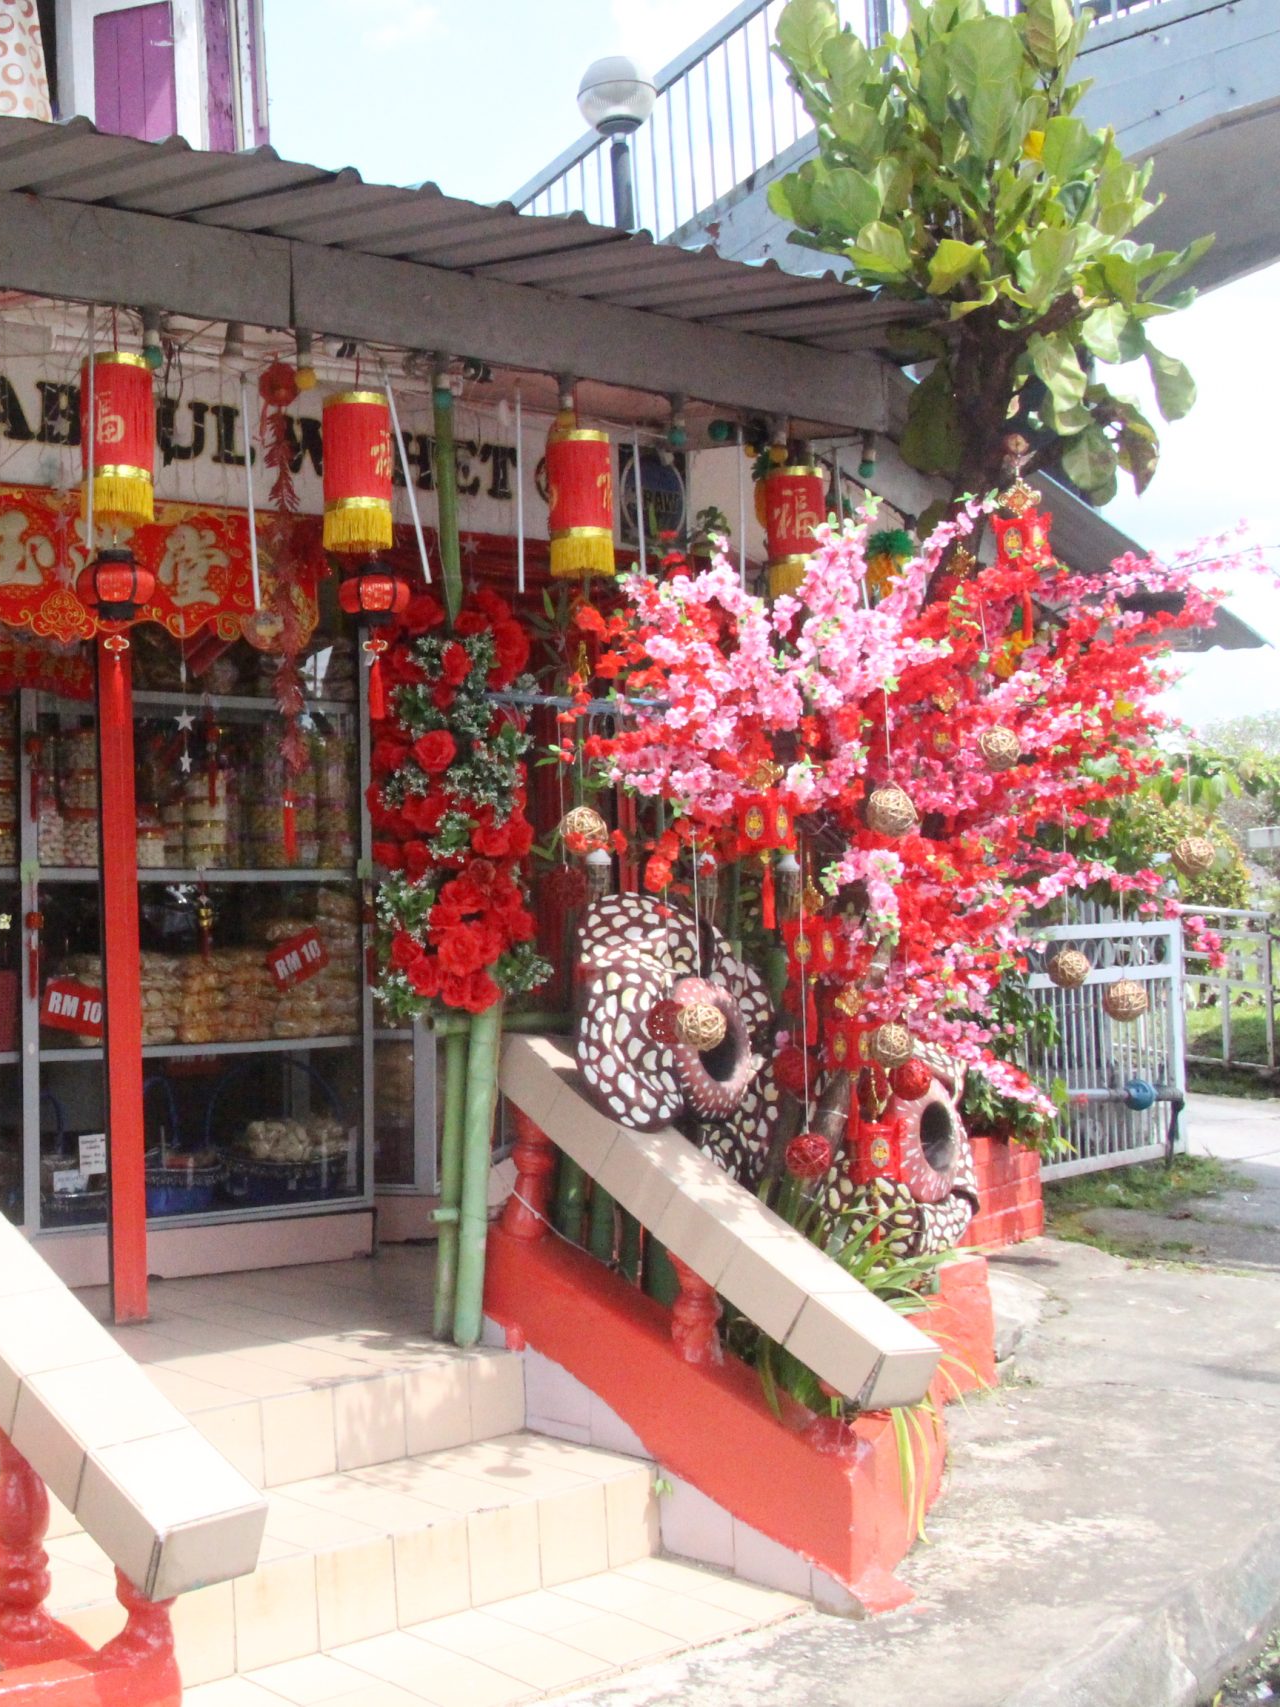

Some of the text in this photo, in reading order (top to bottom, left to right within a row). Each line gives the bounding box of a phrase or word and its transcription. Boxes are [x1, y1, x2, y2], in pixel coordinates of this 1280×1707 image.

[774, 487, 820, 541] 福
[274, 939, 321, 980] RM 10
[48, 991, 102, 1024] RM 10
